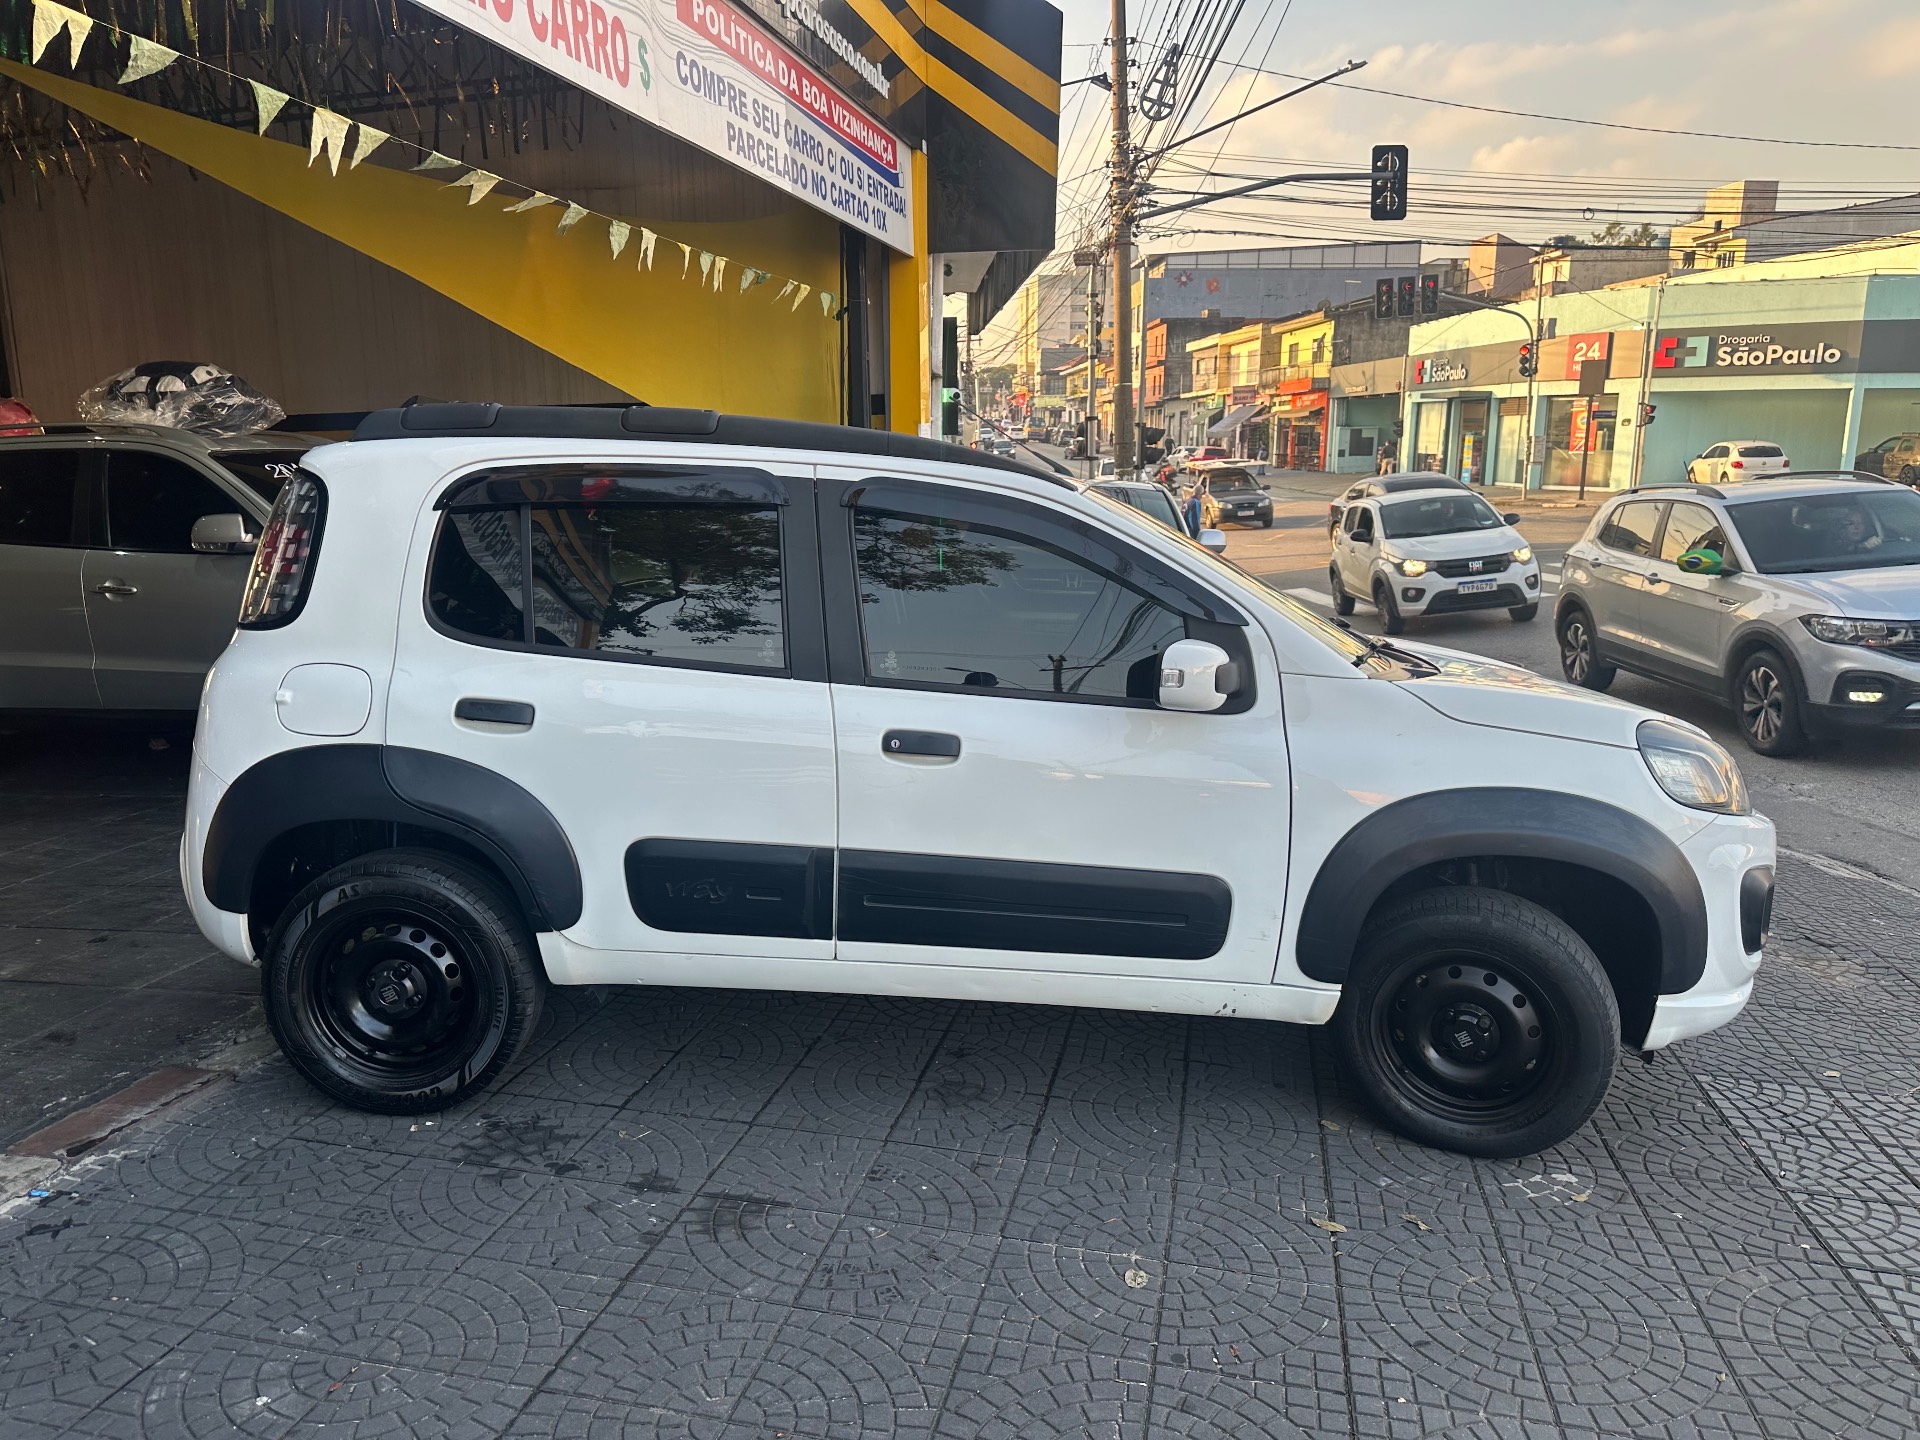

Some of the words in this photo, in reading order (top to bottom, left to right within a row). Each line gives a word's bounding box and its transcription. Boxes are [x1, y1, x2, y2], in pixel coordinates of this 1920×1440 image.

[692, 0, 777, 78] POLÍTICA
[778, 58, 799, 96] DA
[802, 77, 829, 118] BOA
[831, 99, 894, 164] VIZINHANÇA
[675, 51, 749, 122] COMPRE
[752, 98, 780, 139] SEU
[784, 118, 824, 166] CARRO
[840, 156, 855, 185] OU
[868, 176, 907, 218] ENTRADA!
[726, 120, 808, 190] PARCELADO
[811, 168, 828, 201] NO
[871, 208, 888, 233] 10X
[1718, 334, 1771, 345] Drogaria
[1573, 341, 1600, 361] 24
[380, 985, 399, 1003] FIAT
[1454, 1030, 1474, 1048] FIAT
